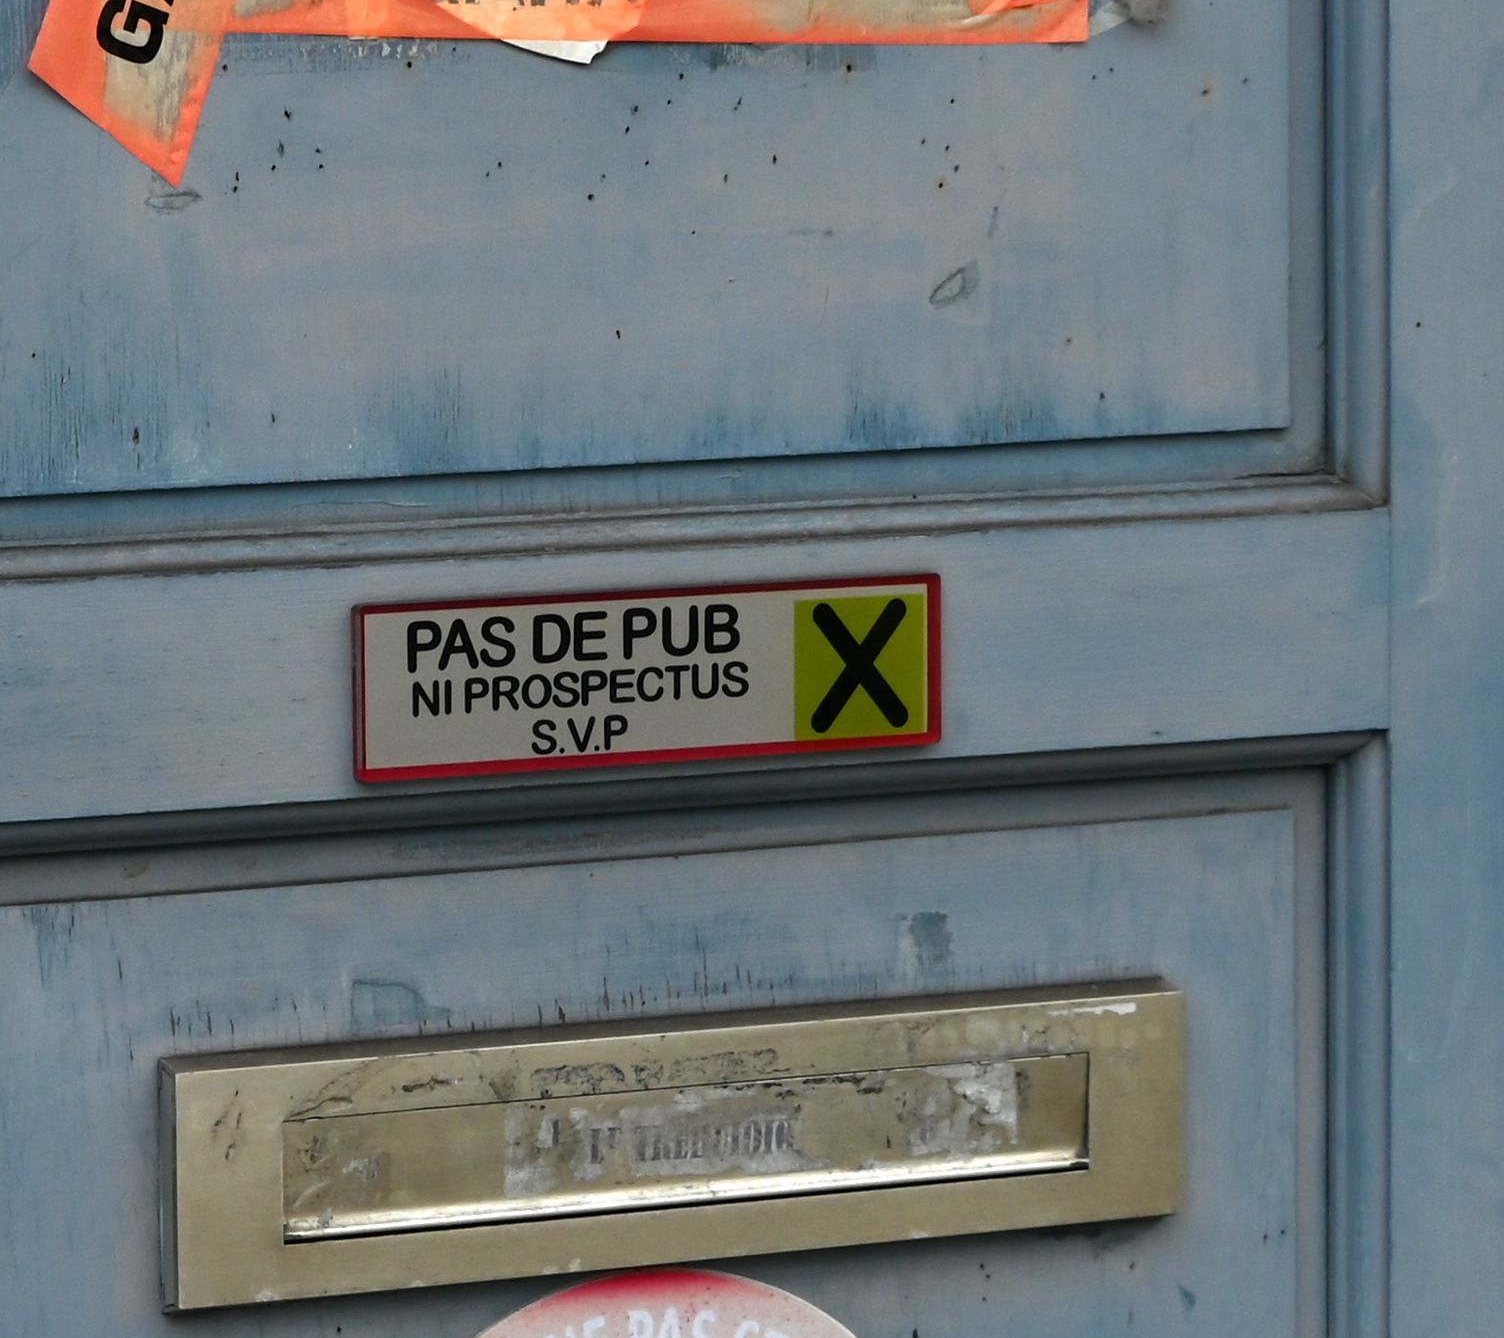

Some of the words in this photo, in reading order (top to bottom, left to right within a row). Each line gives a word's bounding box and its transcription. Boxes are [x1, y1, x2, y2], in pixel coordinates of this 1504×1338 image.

[406, 616, 517, 673] PAS
[532, 610, 609, 663] DE
[622, 603, 742, 659] PUB
[412, 679, 453, 717] NI
[464, 661, 750, 714] PROSPECTUS
[530, 715, 629, 756] S.V.P
